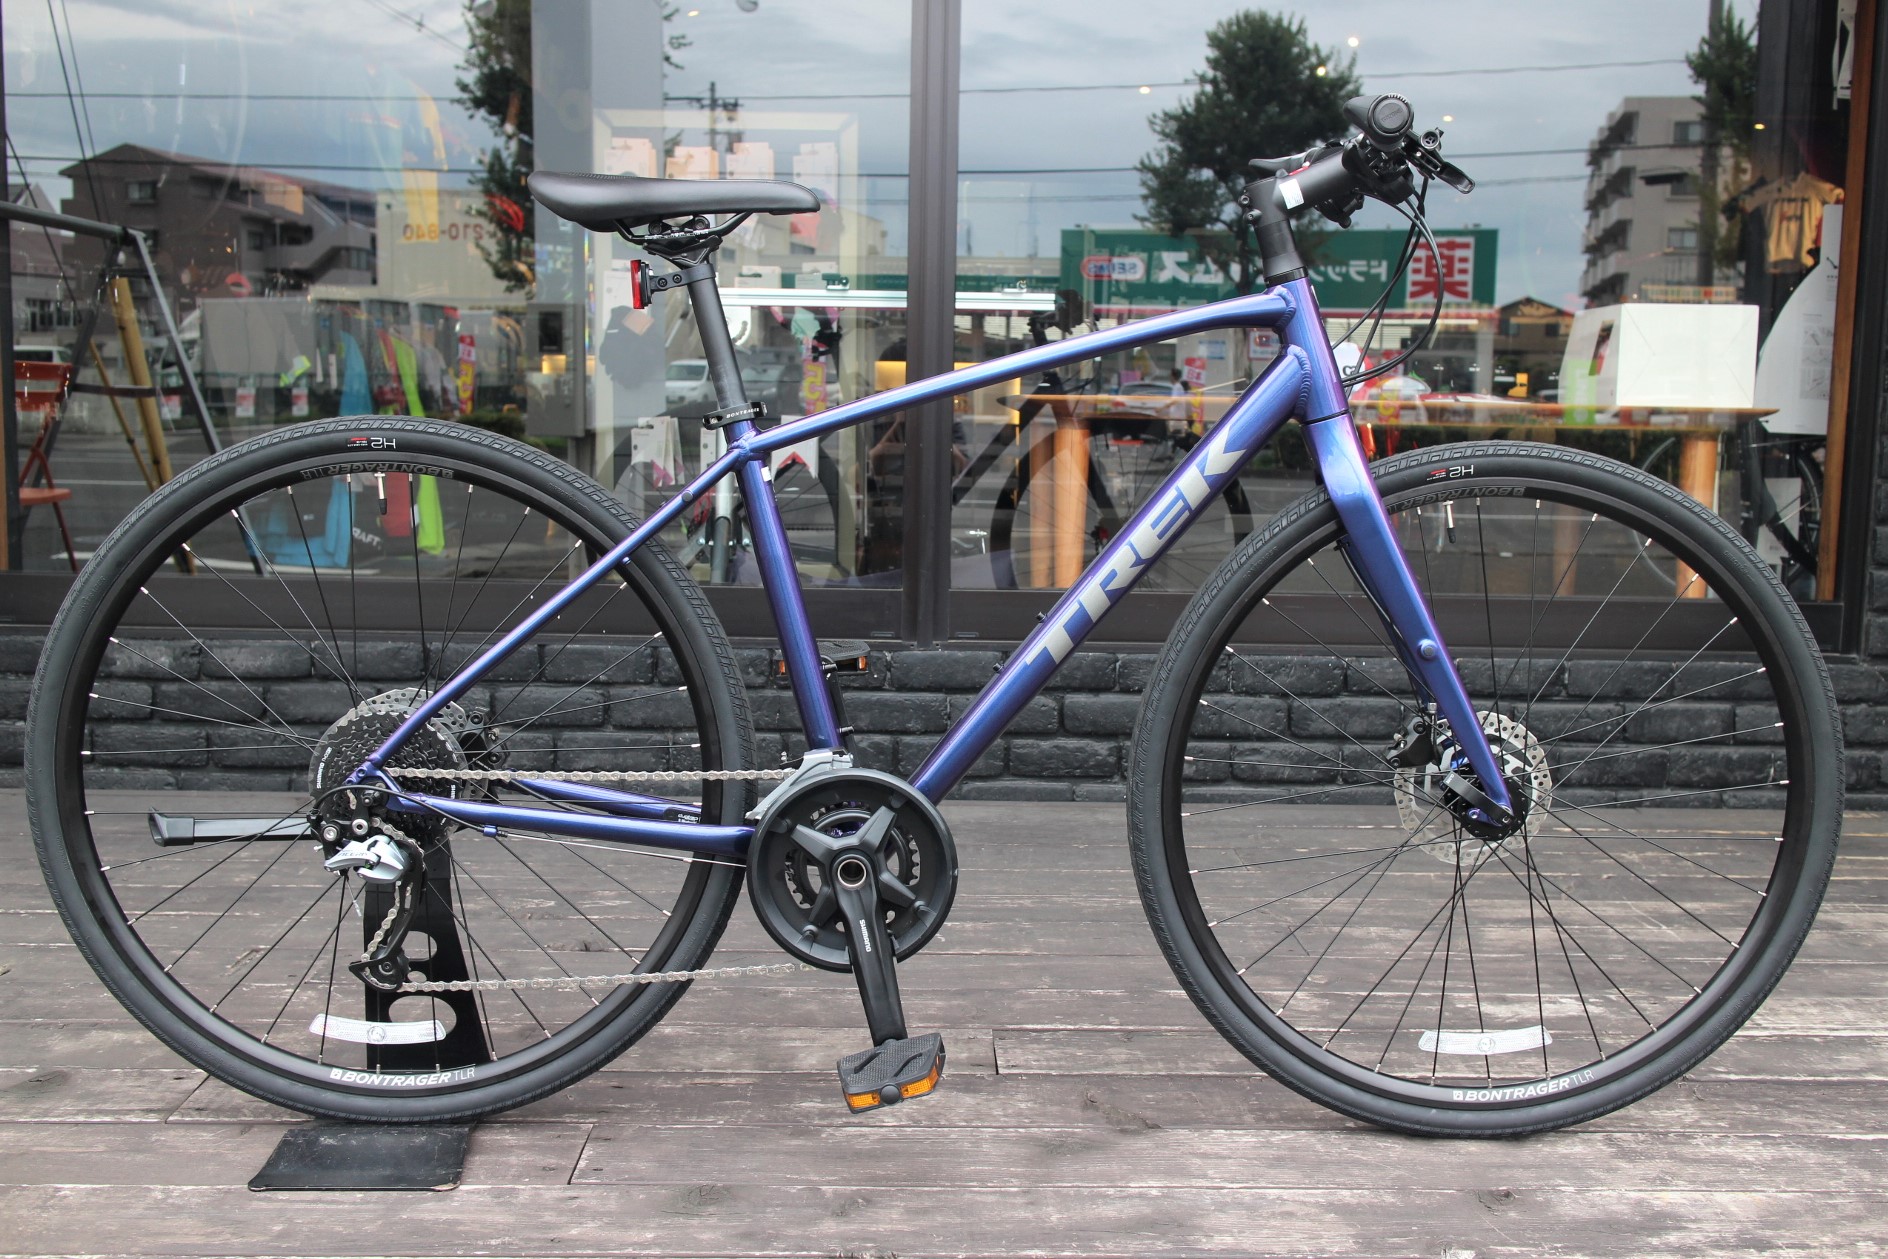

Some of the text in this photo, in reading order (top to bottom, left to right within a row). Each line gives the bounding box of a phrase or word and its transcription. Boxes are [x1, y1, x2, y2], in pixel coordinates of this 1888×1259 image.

[370, 437, 396, 449] H2
[327, 463, 441, 475] BONTRAGER
[1449, 464, 1474, 478] H2
[1402, 487, 1511, 510] BONTRAGER
[352, 527, 381, 546] RAFT
[1026, 424, 1247, 665] TREK
[860, 919, 871, 952] SHIMANO
[341, 1066, 476, 1086] BONTRAGER TLR
[1465, 1070, 1595, 1101] BONTRAGER TLR
